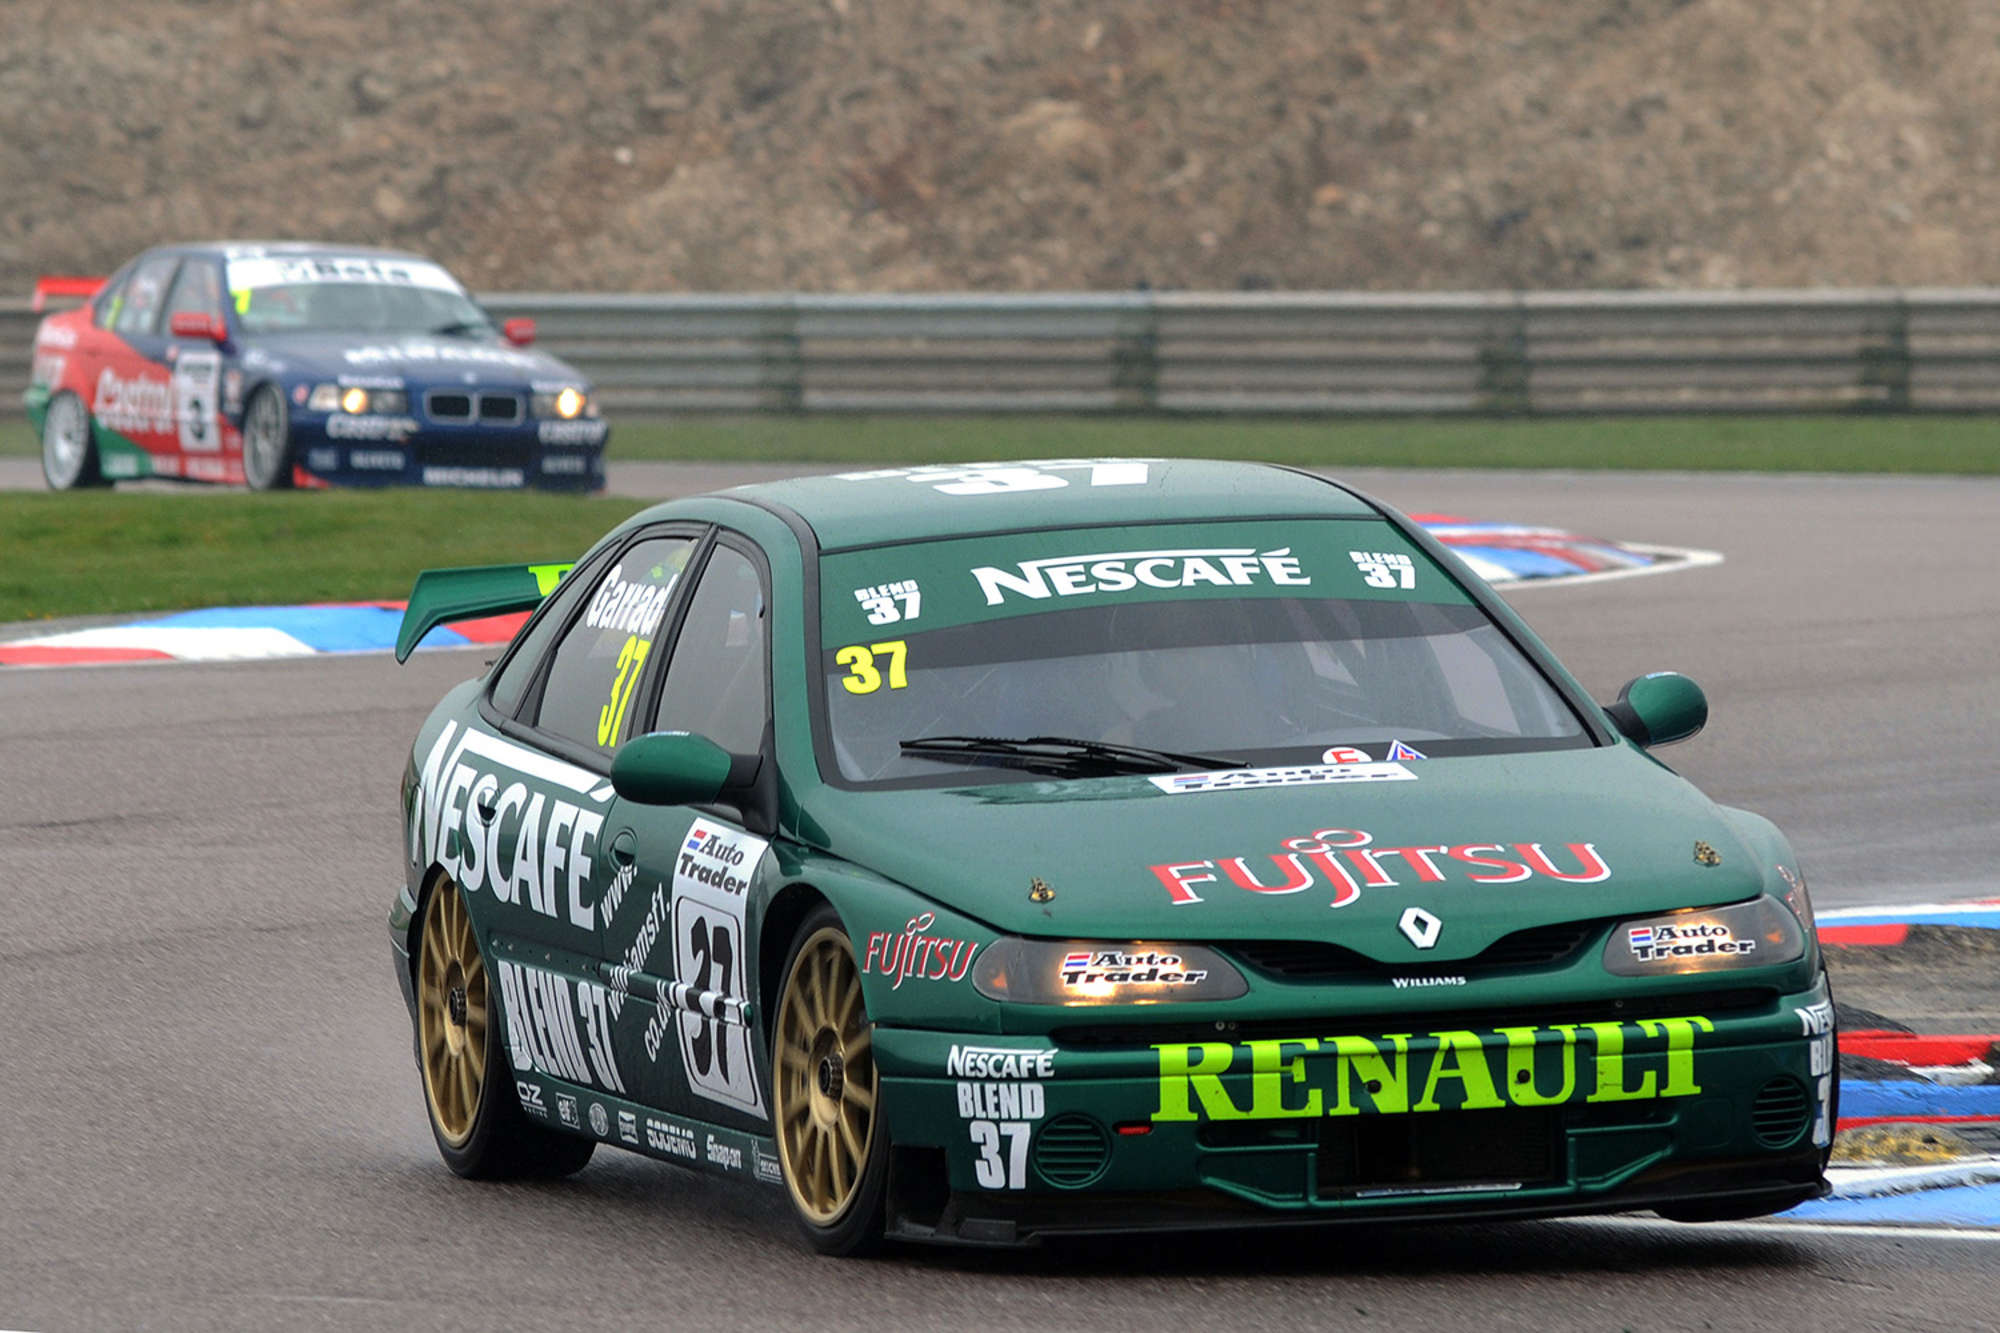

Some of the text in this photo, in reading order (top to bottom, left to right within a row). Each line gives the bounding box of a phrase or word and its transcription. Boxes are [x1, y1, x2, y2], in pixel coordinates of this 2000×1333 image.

[969, 546, 1311, 606] NESCAFÉ
[1349, 551, 1412, 566] BLEND
[1357, 563, 1416, 589] 37
[587, 563, 679, 635] Garrad
[854, 579, 919, 602] BLEND
[861, 591, 921, 625] 37
[836, 640, 908, 694] 37
[597, 634, 651, 747] 37
[699, 834, 744, 866] Auto
[1146, 828, 1612, 908] FUJITSU
[679, 852, 748, 896] Trader
[1631, 938, 1756, 962] Trader
[1655, 923, 1730, 942] Auto
[862, 911, 979, 991] FUJITSU
[1091, 950, 1182, 969] Auto
[1060, 967, 1207, 986] Trader
[1392, 976, 1466, 989] WILLIAMS
[690, 915, 732, 1087] 37
[497, 959, 627, 1095] BLEND 37
[947, 1044, 1059, 1079] NESCAFÉ
[1150, 1016, 1714, 1121] RENAULT
[516, 1080, 544, 1106] OZ
[957, 1082, 1046, 1120] BLEND
[970, 1121, 1032, 1189] 37
